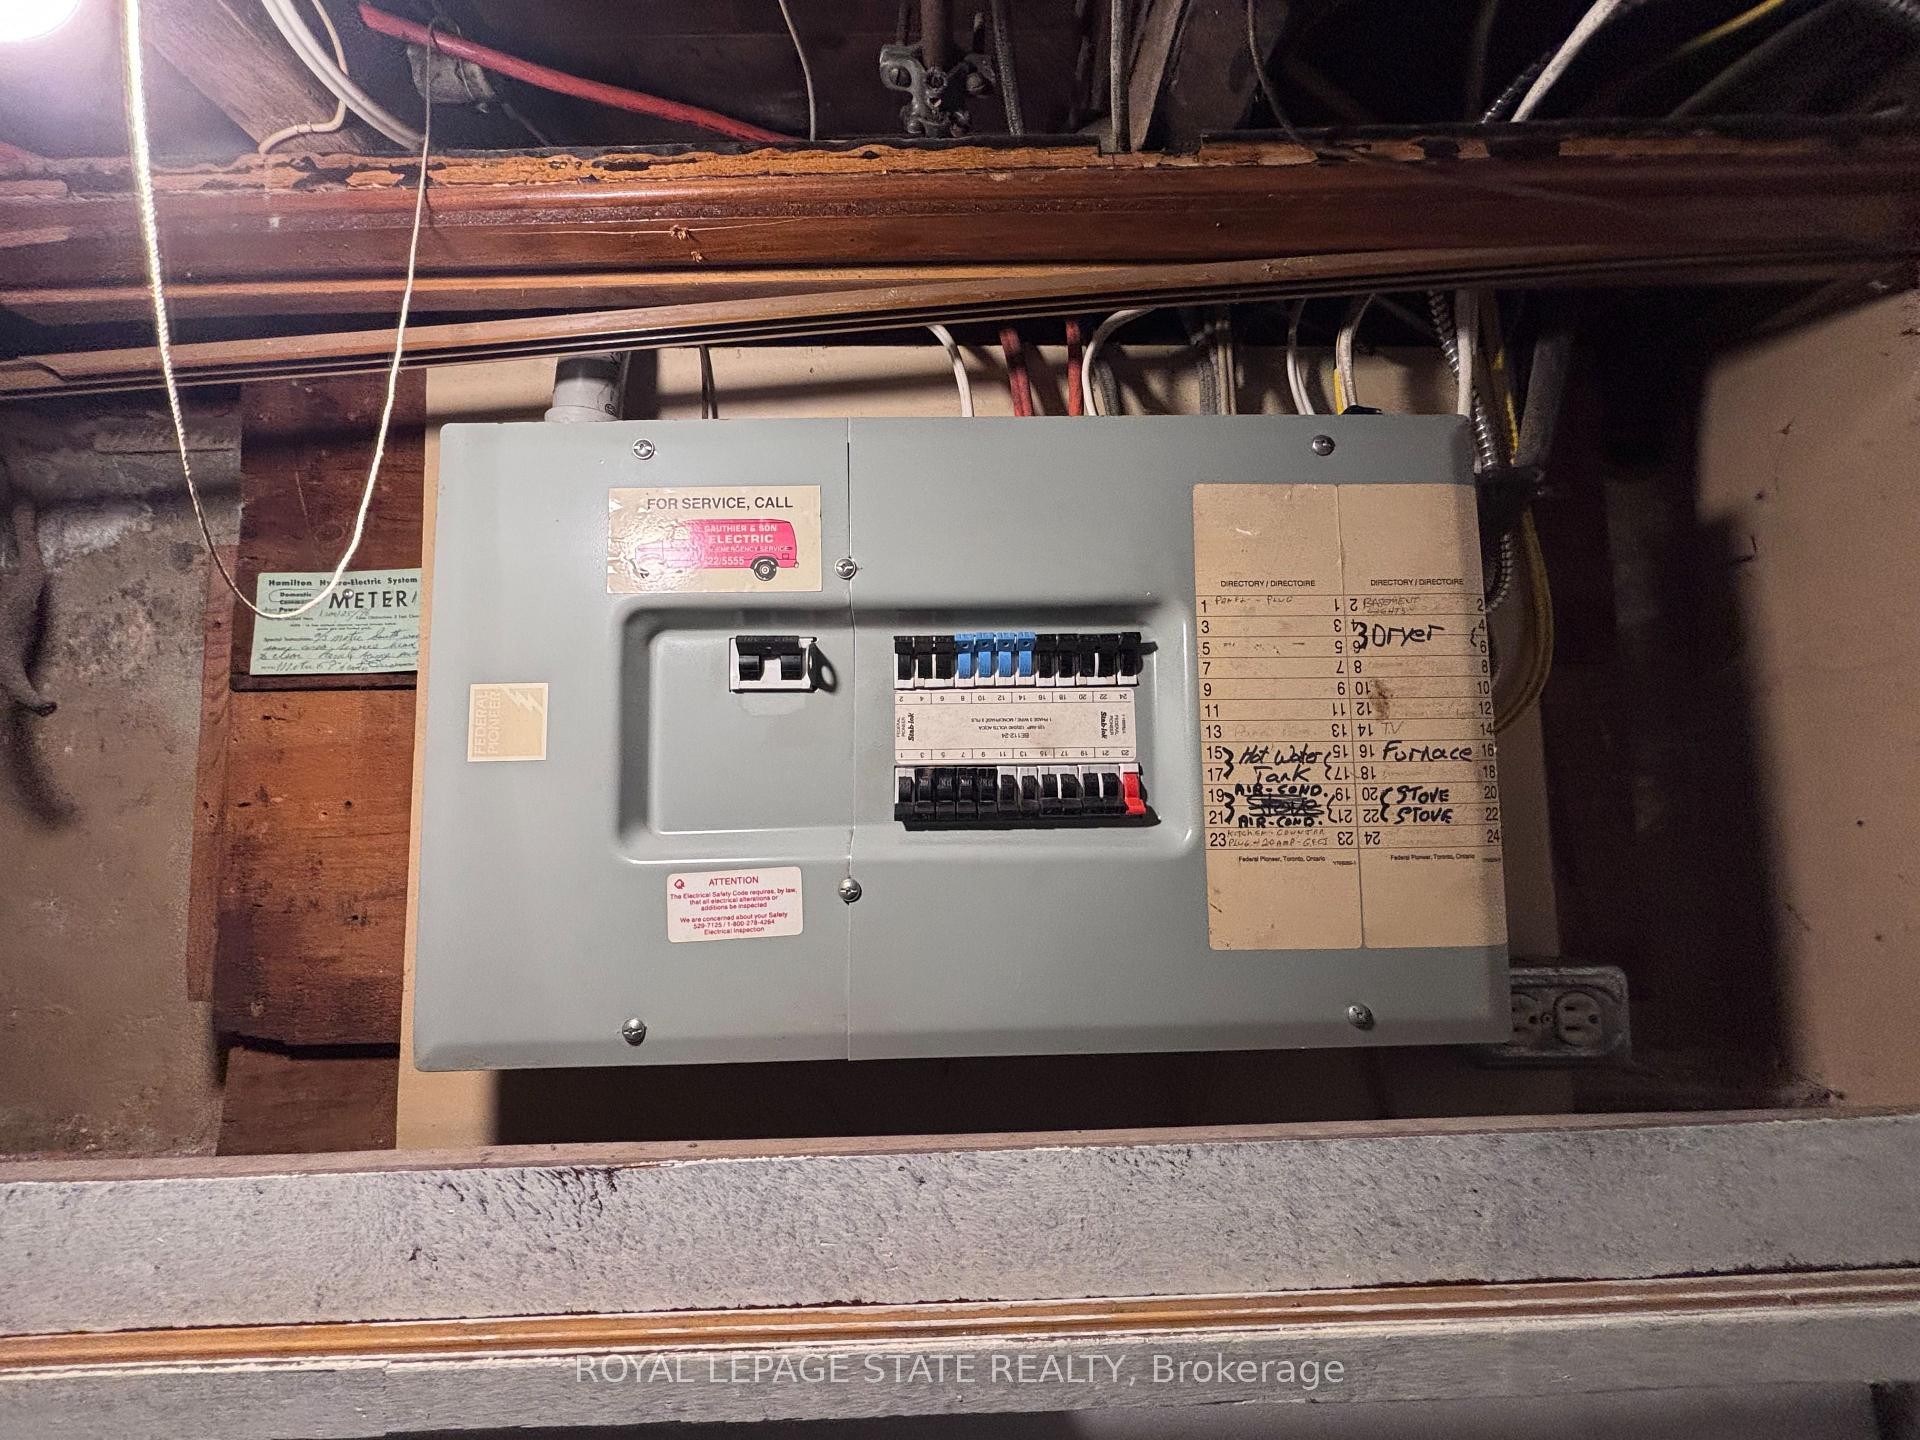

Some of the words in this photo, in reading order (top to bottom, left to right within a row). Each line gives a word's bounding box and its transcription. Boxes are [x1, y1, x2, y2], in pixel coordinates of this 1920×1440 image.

[648, 498, 678, 510] FOR
[682, 497, 750, 511] SERVICE,
[754, 496, 794, 508] CALL
[704, 524, 746, 532] GAUTHIER
[759, 524, 777, 532] SON
[708, 534, 774, 544] ELECTRIC
[320, 578, 381, 587] Hyro-Electric
[388, 577, 418, 586] System
[1220, 580, 1264, 588] DIRECTORY
[1270, 580, 1316, 588] DIRECTOIRE
[1370, 578, 1414, 586] DIRECTORY
[1418, 578, 1464, 586] DIRECTOIRE
[329, 590, 408, 609] METER
[1201, 600, 1206, 612] 1
[1334, 598, 1340, 611] 1
[1350, 598, 1358, 612] 2
[1477, 598, 1484, 612] 2
[1201, 620, 1210, 634] 3
[1334, 619, 1342, 632] 3
[1478, 618, 1486, 632] 4
[1372, 623, 1445, 646] Dryer
[1202, 642, 1210, 654] 5
[1335, 640, 1342, 654] 5
[1480, 640, 1487, 654] 6
[1202, 662, 1210, 674] 7
[1336, 660, 1344, 674] 7
[1354, 660, 1362, 674] 8
[1481, 660, 1488, 673] 8
[1204, 683, 1212, 696] 9
[1337, 682, 1346, 695] 9
[1356, 682, 1371, 694] 10
[1477, 681, 1490, 694] 10
[1204, 704, 1219, 717] 11
[1332, 702, 1346, 716] 11
[1356, 702, 1372, 716] 12
[1478, 702, 1492, 714] 12
[1206, 724, 1222, 738] 13
[1332, 724, 1348, 737] 13
[1358, 724, 1373, 736] 14
[1480, 723, 1494, 736] 14
[1206, 746, 1222, 759] 15
[1239, 745, 1270, 764] Hot
[1274, 744, 1323, 766] Water
[1332, 745, 1348, 758] 15
[1360, 744, 1374, 758] 16
[1382, 740, 1473, 762] Furnace
[1482, 744, 1494, 757] 16
[1208, 768, 1224, 781] 17
[1254, 764, 1311, 784] Tank
[1334, 766, 1350, 780] 17
[1360, 766, 1376, 780] 18
[1482, 766, 1496, 778] 18
[1208, 788, 1224, 802] 19
[1336, 788, 1351, 801] 19
[1362, 787, 1378, 800] 20
[1396, 785, 1450, 804] STOVE
[1484, 786, 1497, 799] 20
[1209, 810, 1224, 824] 21
[1338, 810, 1352, 824] 21
[1364, 809, 1379, 822] 22
[1394, 806, 1454, 824] STOVE
[1486, 808, 1498, 821] 22
[1210, 832, 1226, 846] 23
[1338, 832, 1354, 846] 23
[1364, 832, 1380, 845] 24
[1487, 830, 1500, 843] 24
[709, 876, 758, 886] ATTENTION
[738, 902, 768, 910] inspected
